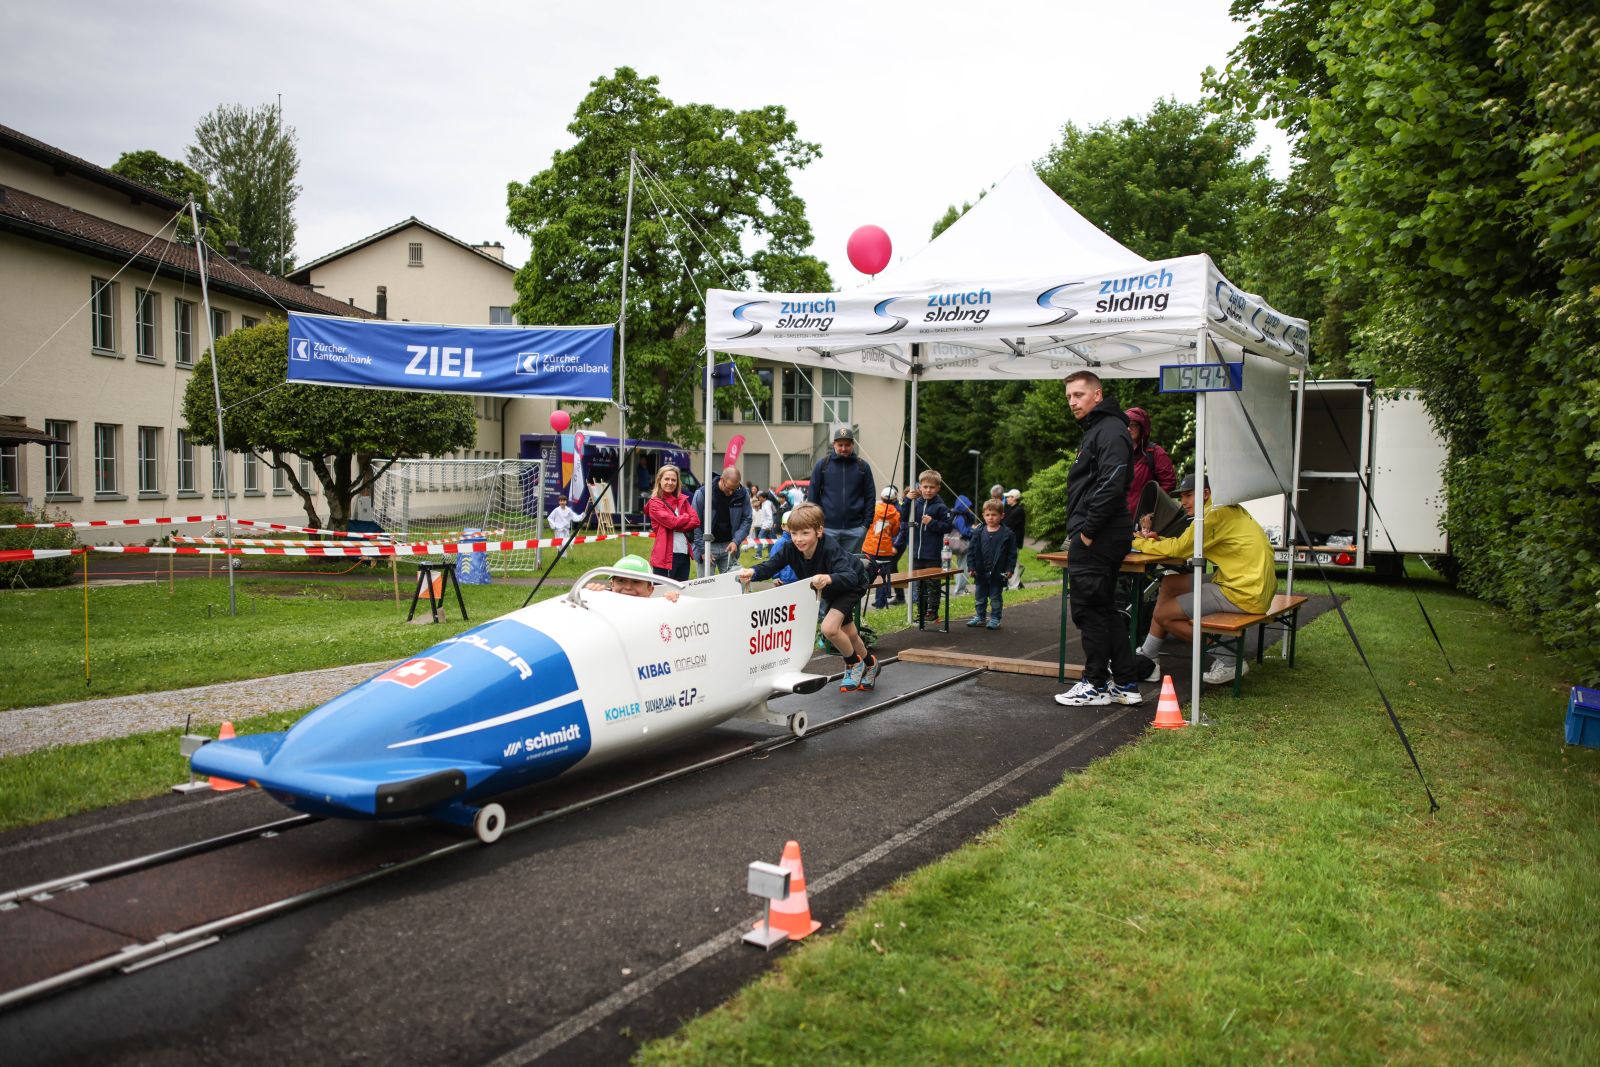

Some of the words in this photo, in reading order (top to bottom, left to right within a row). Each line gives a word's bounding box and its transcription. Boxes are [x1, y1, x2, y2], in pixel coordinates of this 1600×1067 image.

[1099, 268, 1173, 295] zurich
[780, 297, 836, 314] zurich
[926, 288, 991, 307] zurich
[1095, 291, 1170, 313] sliding
[775, 314, 834, 331] sliding
[923, 306, 990, 324] sliding
[313, 342, 347, 354] Zürcher
[313, 351, 372, 366] Kantonalbank
[404, 345, 482, 378] ZIEL
[543, 354, 580, 364] Zürcher
[543, 362, 609, 374] Kantonalbank
[751, 605, 788, 629] SWISS
[674, 621, 710, 642] aprica
[749, 627, 792, 655] sliding
[637, 661, 671, 680] KIBAG
[604, 703, 640, 721] KOHLER
[645, 694, 677, 712] SILVAPLANA
[525, 723, 581, 752] schmidt
